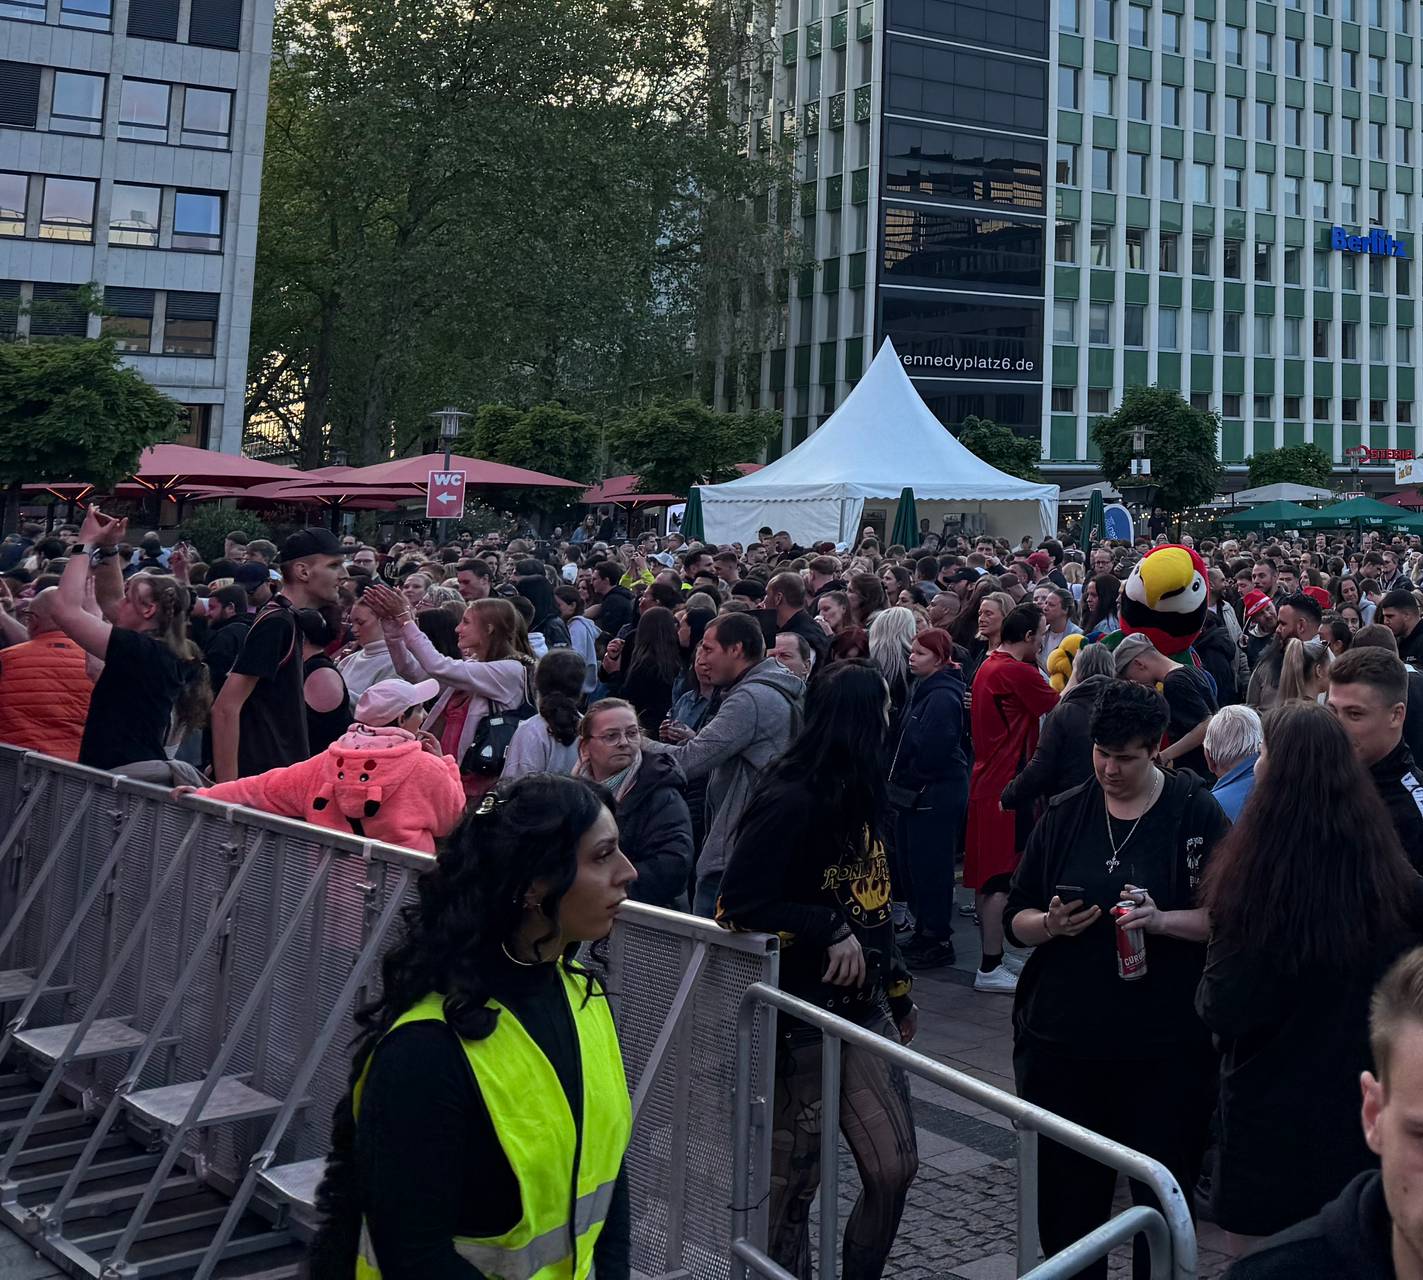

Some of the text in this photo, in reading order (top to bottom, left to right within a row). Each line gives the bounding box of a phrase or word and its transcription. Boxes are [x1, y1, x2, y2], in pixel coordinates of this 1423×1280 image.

[1332, 226, 1407, 257] Berlitz
[898, 354, 1034, 371] ennedyplatz6.de
[434, 474, 462, 486] WC
